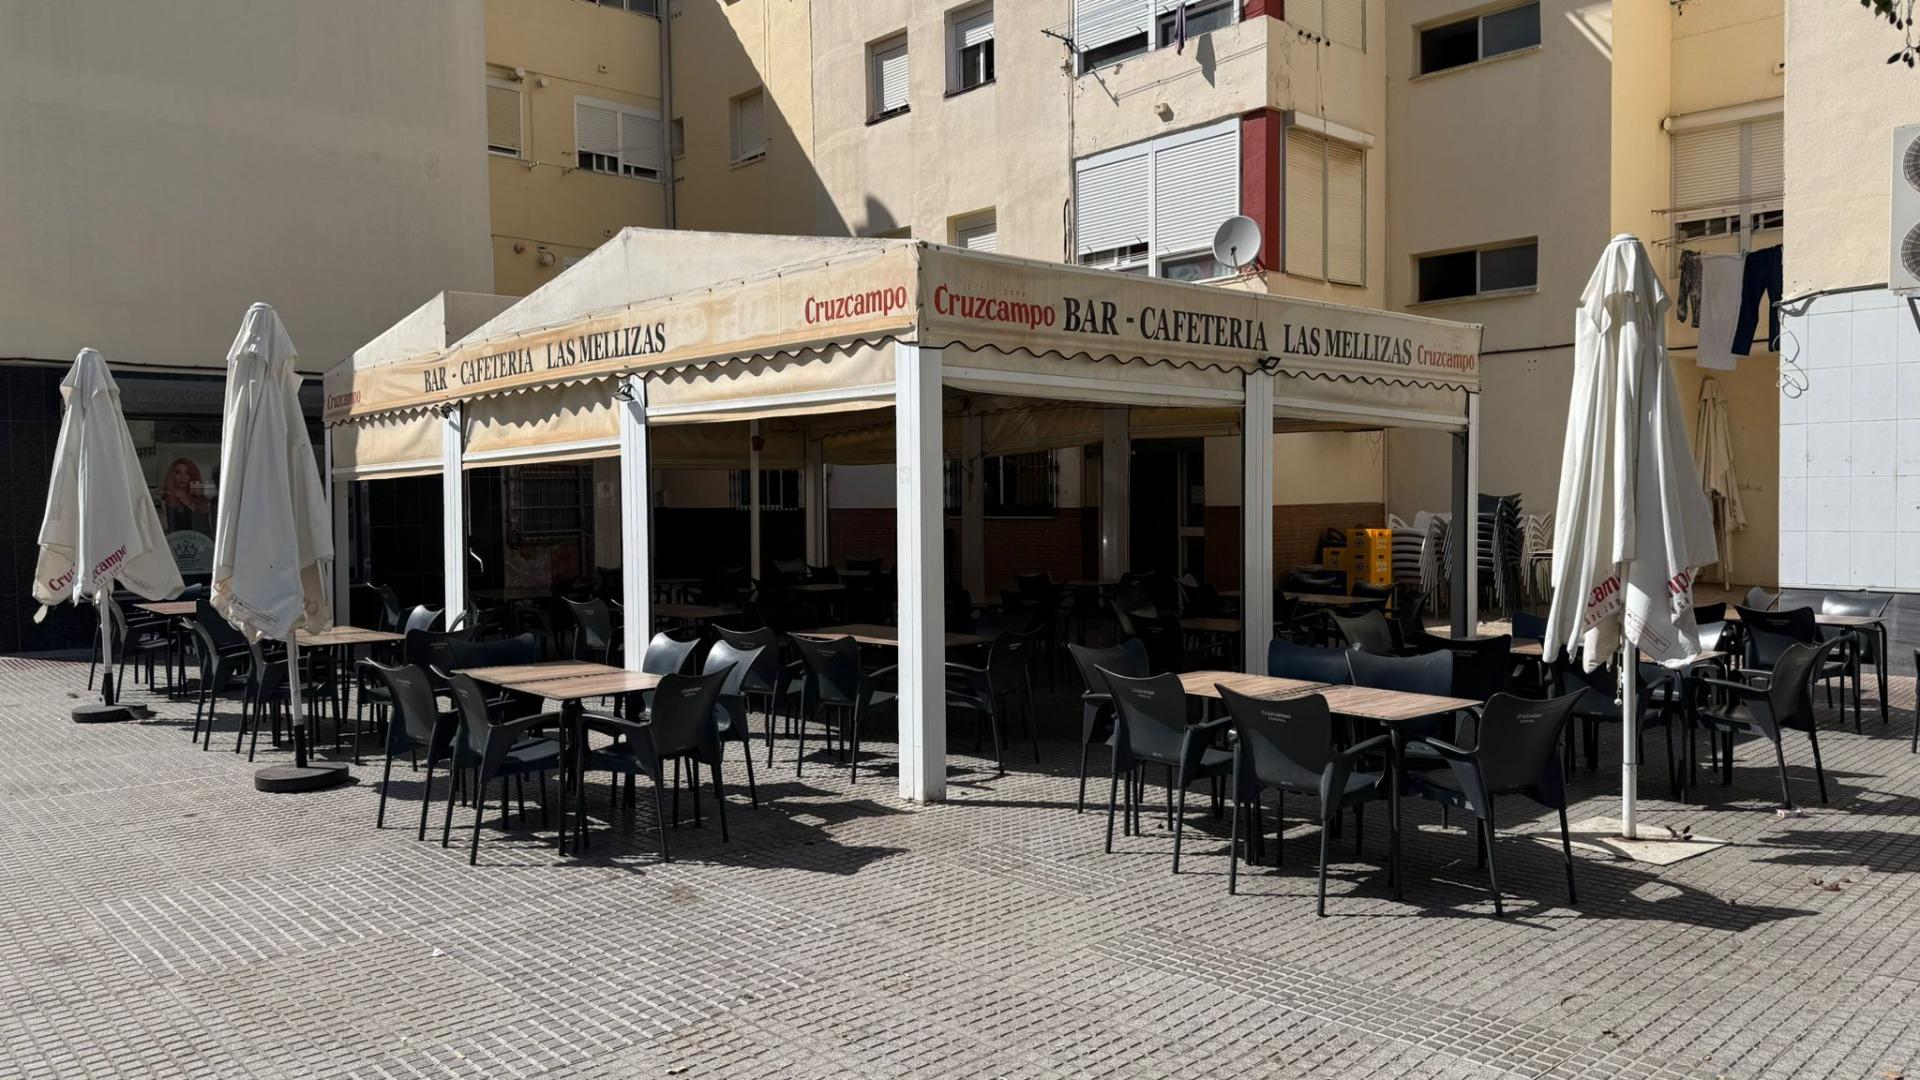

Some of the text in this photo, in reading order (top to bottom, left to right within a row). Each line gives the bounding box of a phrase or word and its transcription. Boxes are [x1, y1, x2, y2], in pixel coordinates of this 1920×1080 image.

[327, 390, 361, 411] Cruzcampo
[423, 366, 448, 393] BAR
[460, 347, 534, 385] CAFETERIA
[546, 338, 576, 369] LAS
[579, 322, 666, 363] MELLIZAS
[804, 284, 908, 325] Cruzcampo
[933, 283, 1056, 330] Cruzcampo
[1063, 297, 1119, 336] BAR
[1139, 306, 1269, 352] CAFETERIA
[1283, 323, 1321, 356] LAS
[1324, 328, 1412, 366] MELLIZAS
[1416, 344, 1475, 373] Cruzcampo
